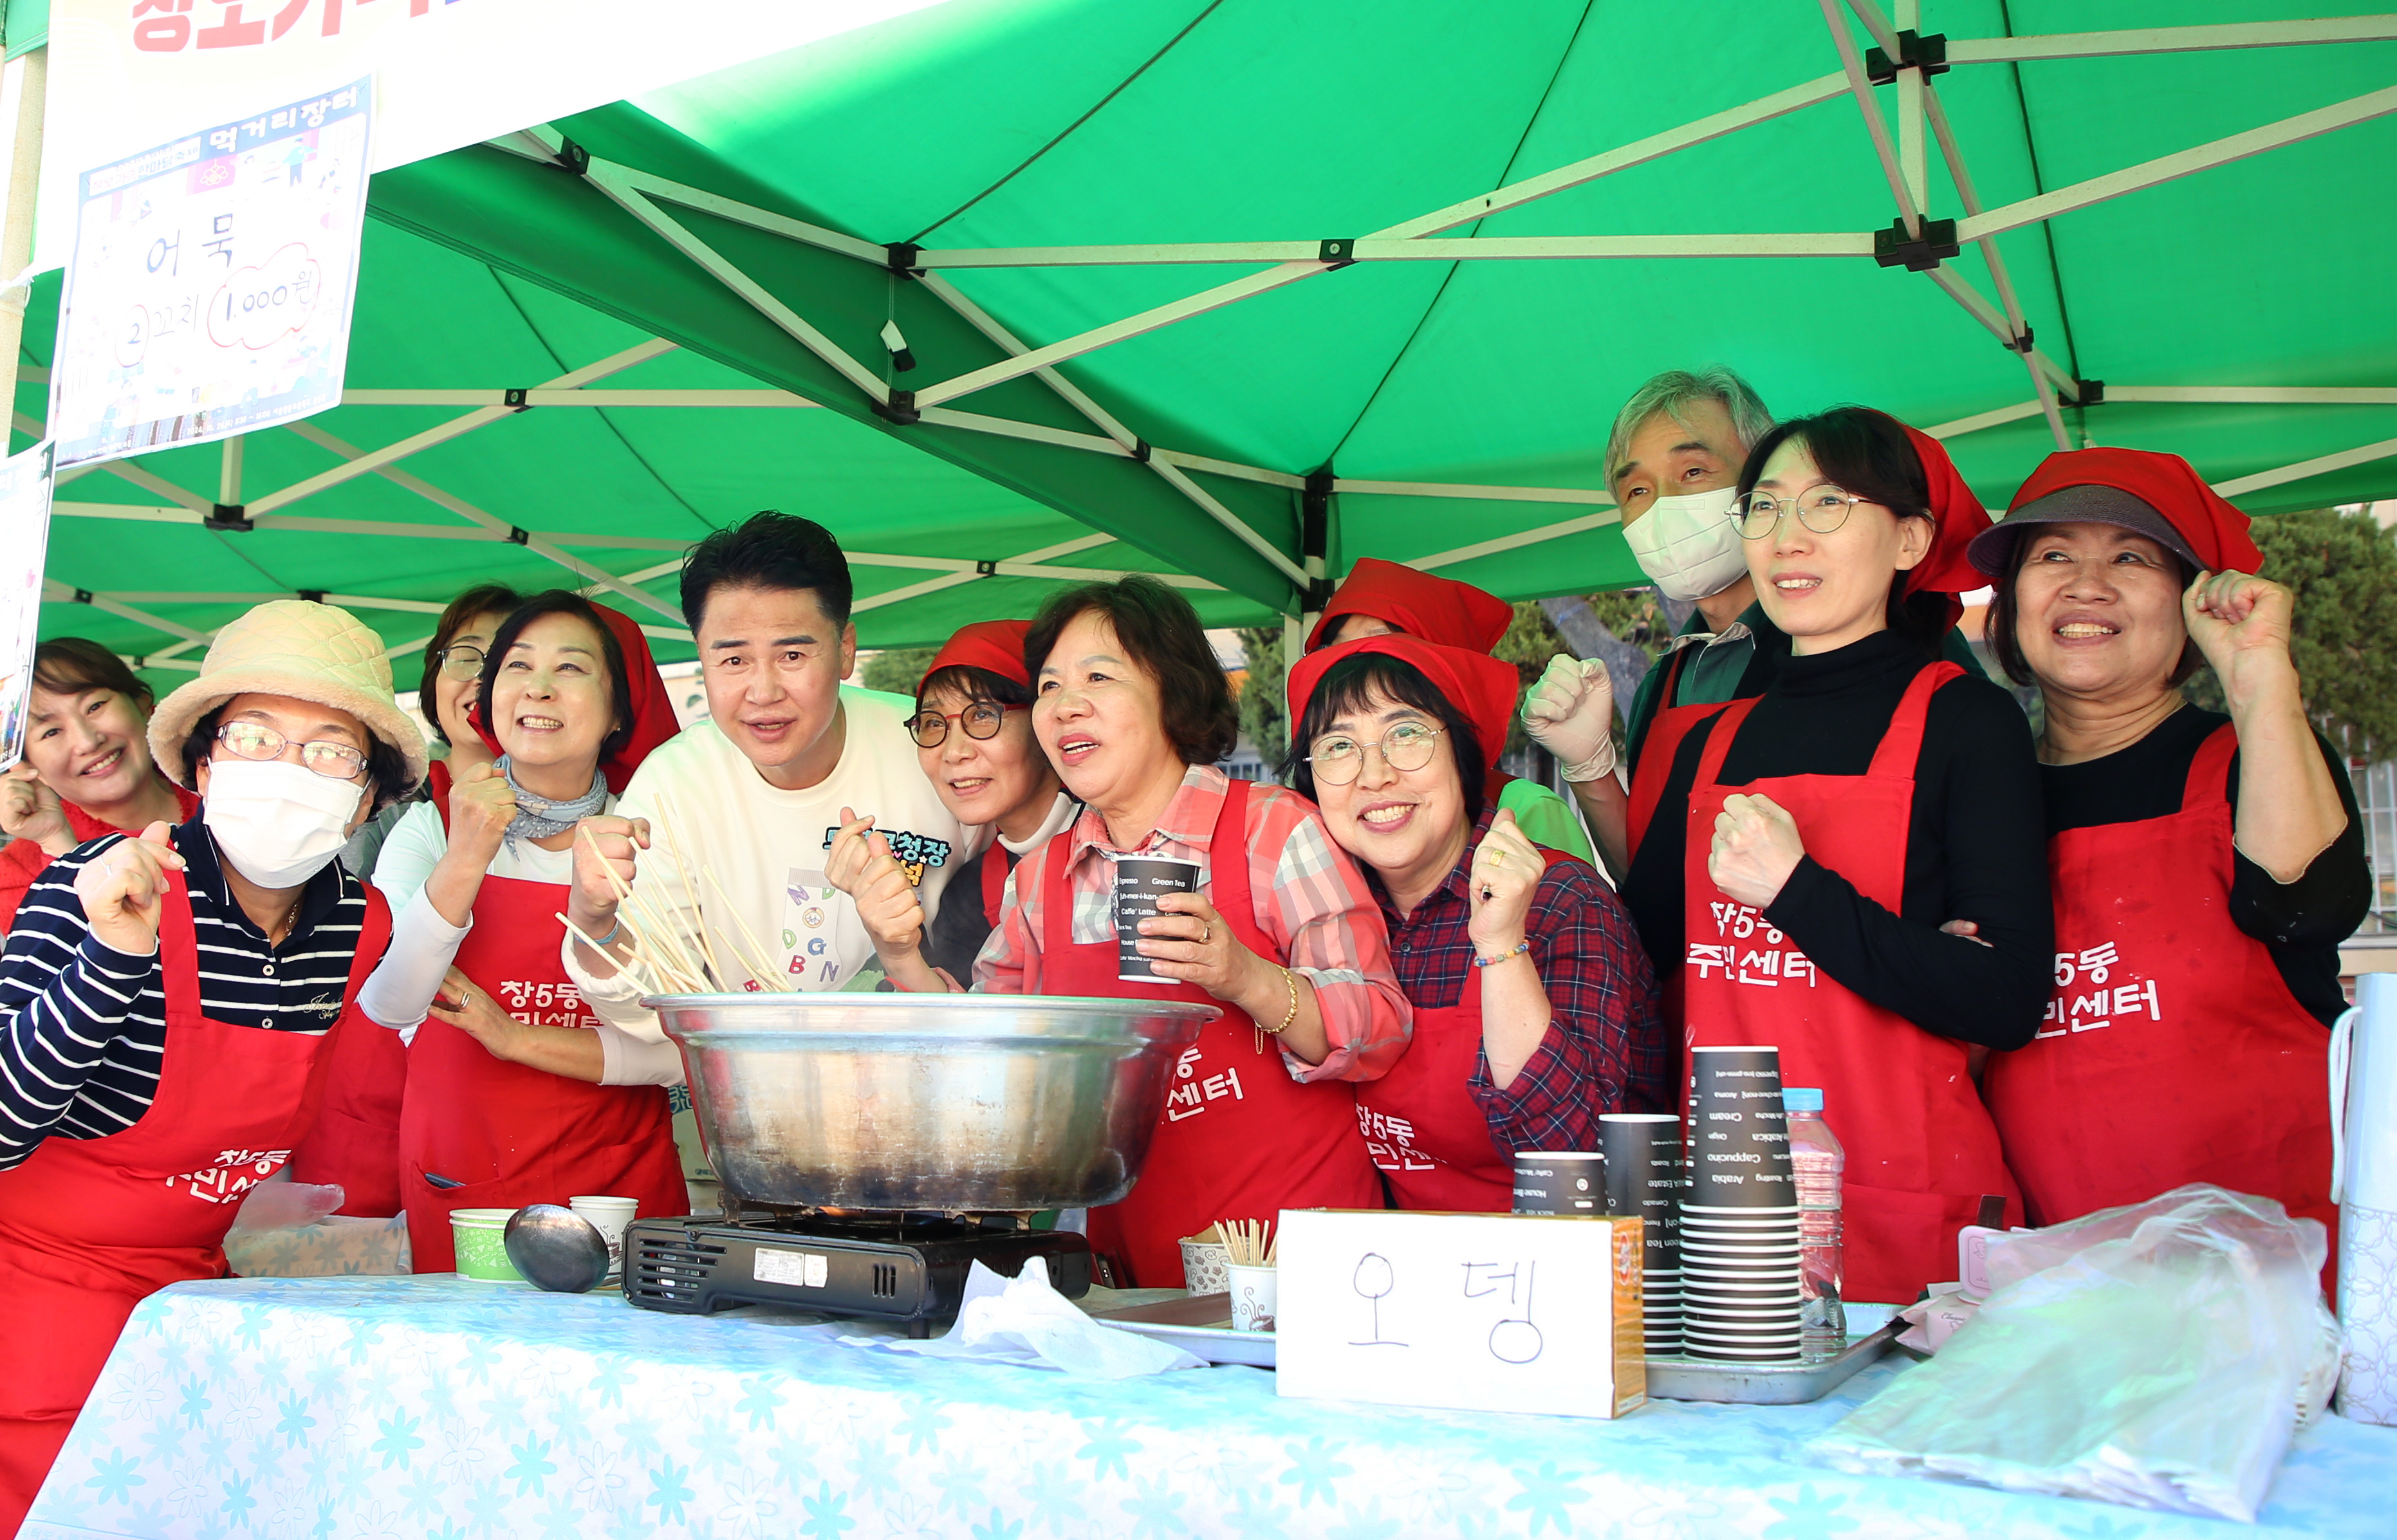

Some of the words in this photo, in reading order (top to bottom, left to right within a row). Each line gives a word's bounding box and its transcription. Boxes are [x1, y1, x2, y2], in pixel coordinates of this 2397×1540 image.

[209, 86, 358, 153] 먹거리장터
[147, 213, 234, 277] 어묵
[1151, 878, 1174, 886] Green
[807, 937, 828, 956] G
[788, 954, 806, 974] B
[499, 980, 579, 1010] 창5동
[1708, 1112, 1743, 1122] Cream
[1647, 1180, 1673, 1188] Estate
[1712, 1174, 1745, 1185] Arabia
[1646, 1239, 1663, 1248] Tea
[1348, 1252, 1544, 1364] 오뎅
